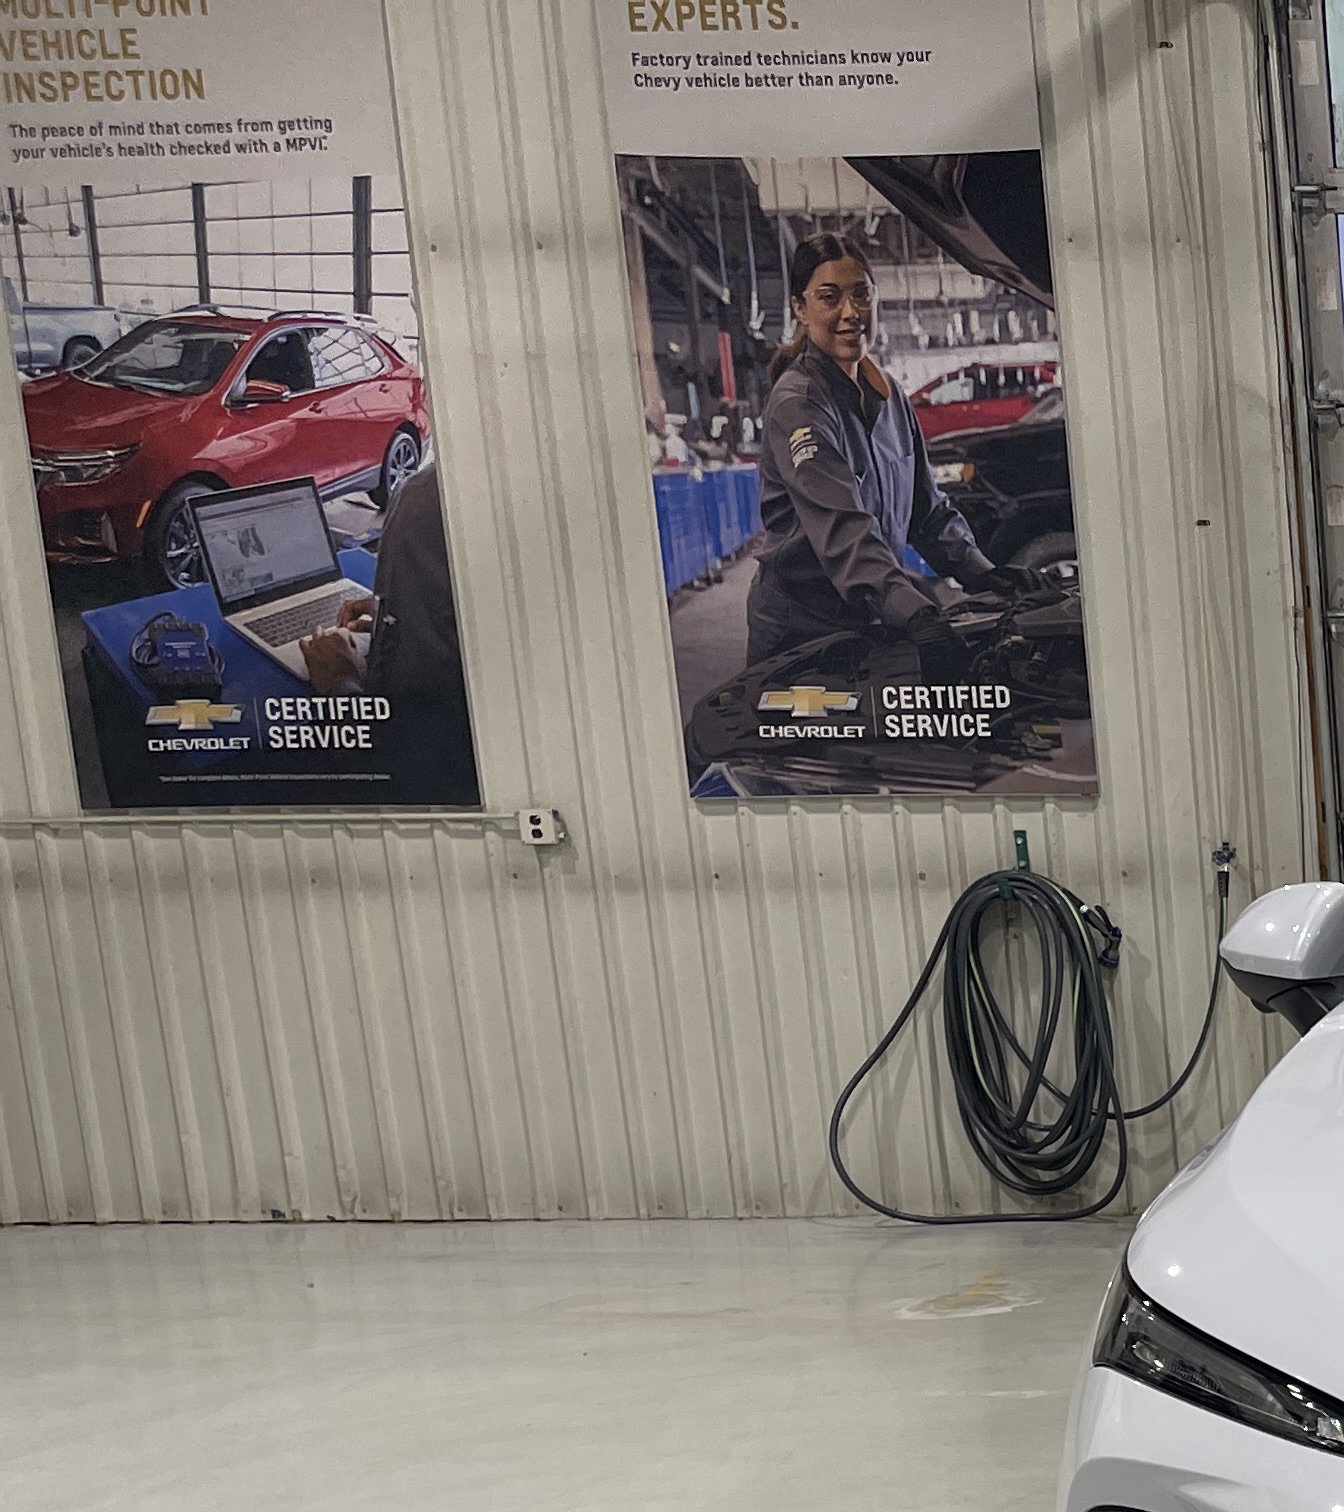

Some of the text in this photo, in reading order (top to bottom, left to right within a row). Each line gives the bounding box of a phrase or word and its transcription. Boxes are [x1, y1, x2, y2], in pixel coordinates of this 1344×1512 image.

[628, 0, 799, 32] EXPERTS.
[0, 28, 140, 61] VEHICLE
[631, 50, 932, 69] Factory trained technicians know your
[3, 68, 206, 103] INSPECTION
[633, 71, 898, 91] Chevy vehicle better than anyone.
[9, 115, 333, 141] The peace of mind that comes from getting
[12, 147, 46, 163] your
[50, 142, 115, 158] vehicle's
[118, 141, 165, 157] health
[169, 139, 231, 156] checked
[235, 138, 269, 154] with
[273, 141, 281, 152] a
[265, 697, 391, 721] CERTIFIED
[882, 685, 1011, 709] CERTIFIED
[268, 725, 373, 749] SERVICE
[758, 725, 866, 739] CHEVROLET
[885, 713, 991, 738] SERVICE
[147, 737, 252, 752] CHEVROLET
